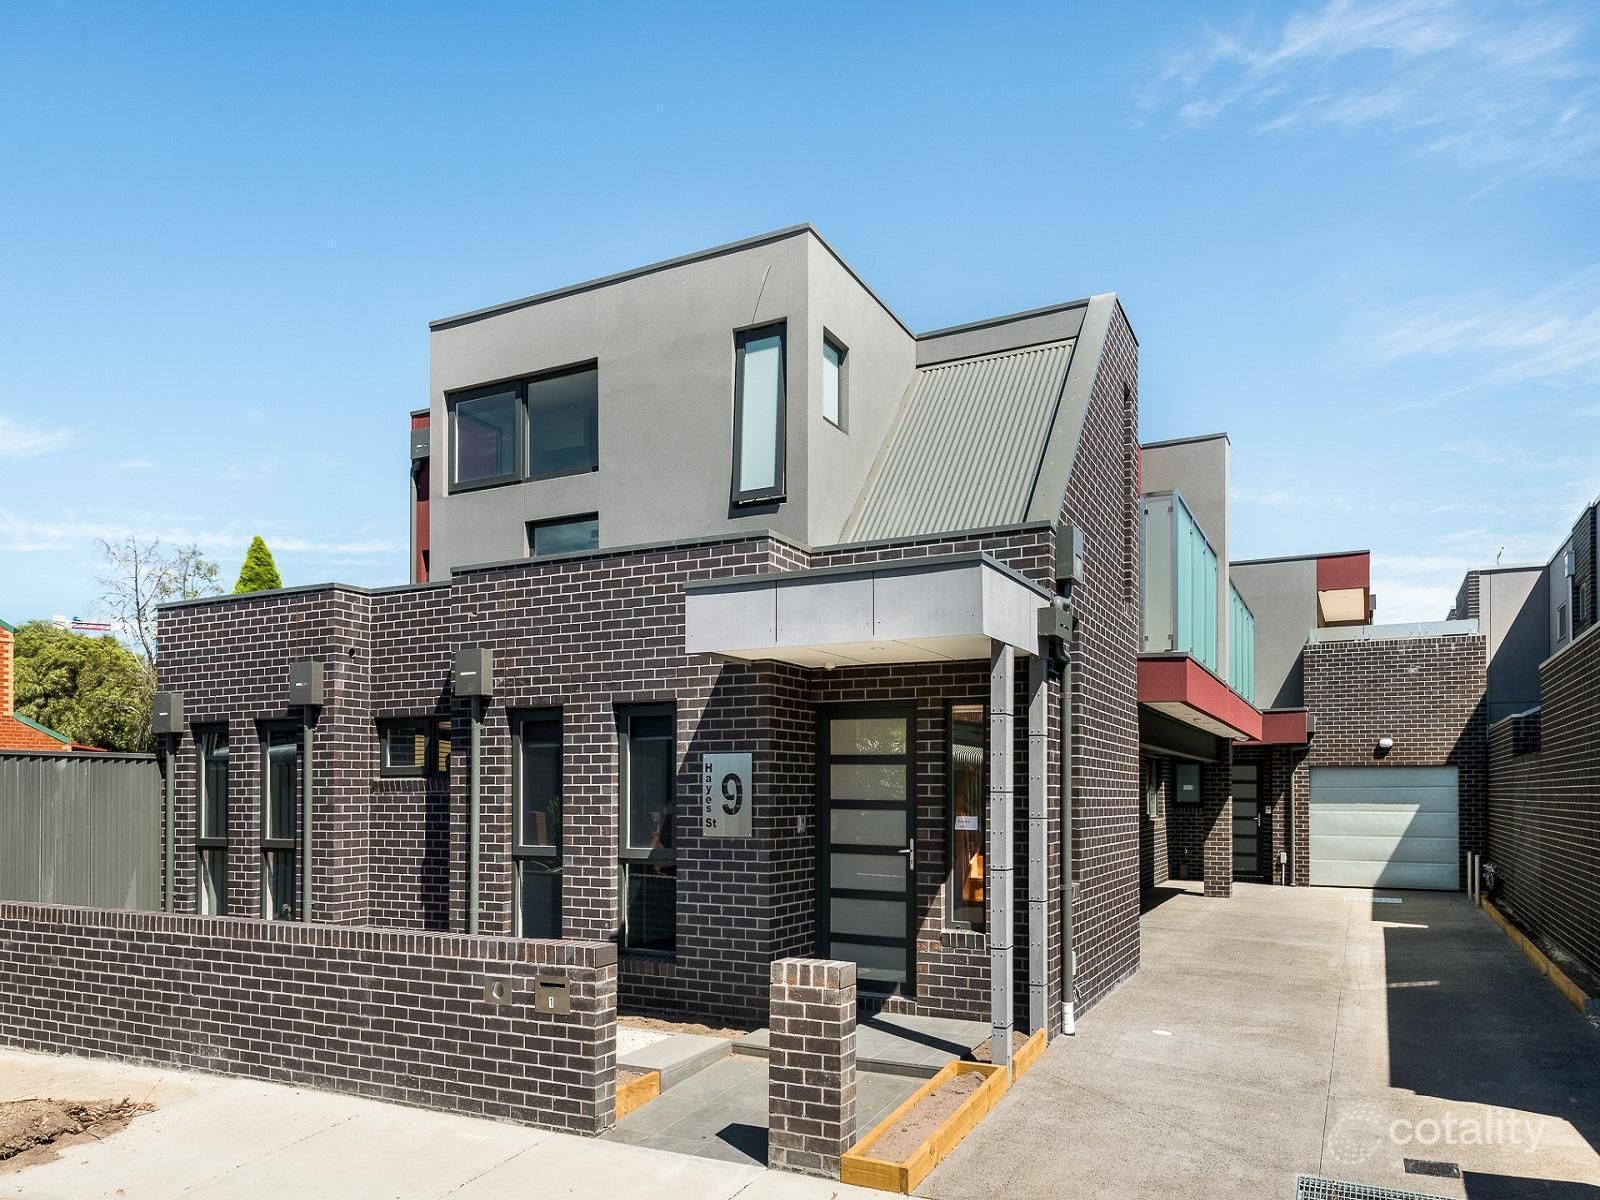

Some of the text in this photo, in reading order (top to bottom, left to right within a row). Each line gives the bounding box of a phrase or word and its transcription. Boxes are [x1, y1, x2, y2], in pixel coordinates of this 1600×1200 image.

[705, 763, 717, 828] Hayes St
[721, 773, 743, 816] 9
